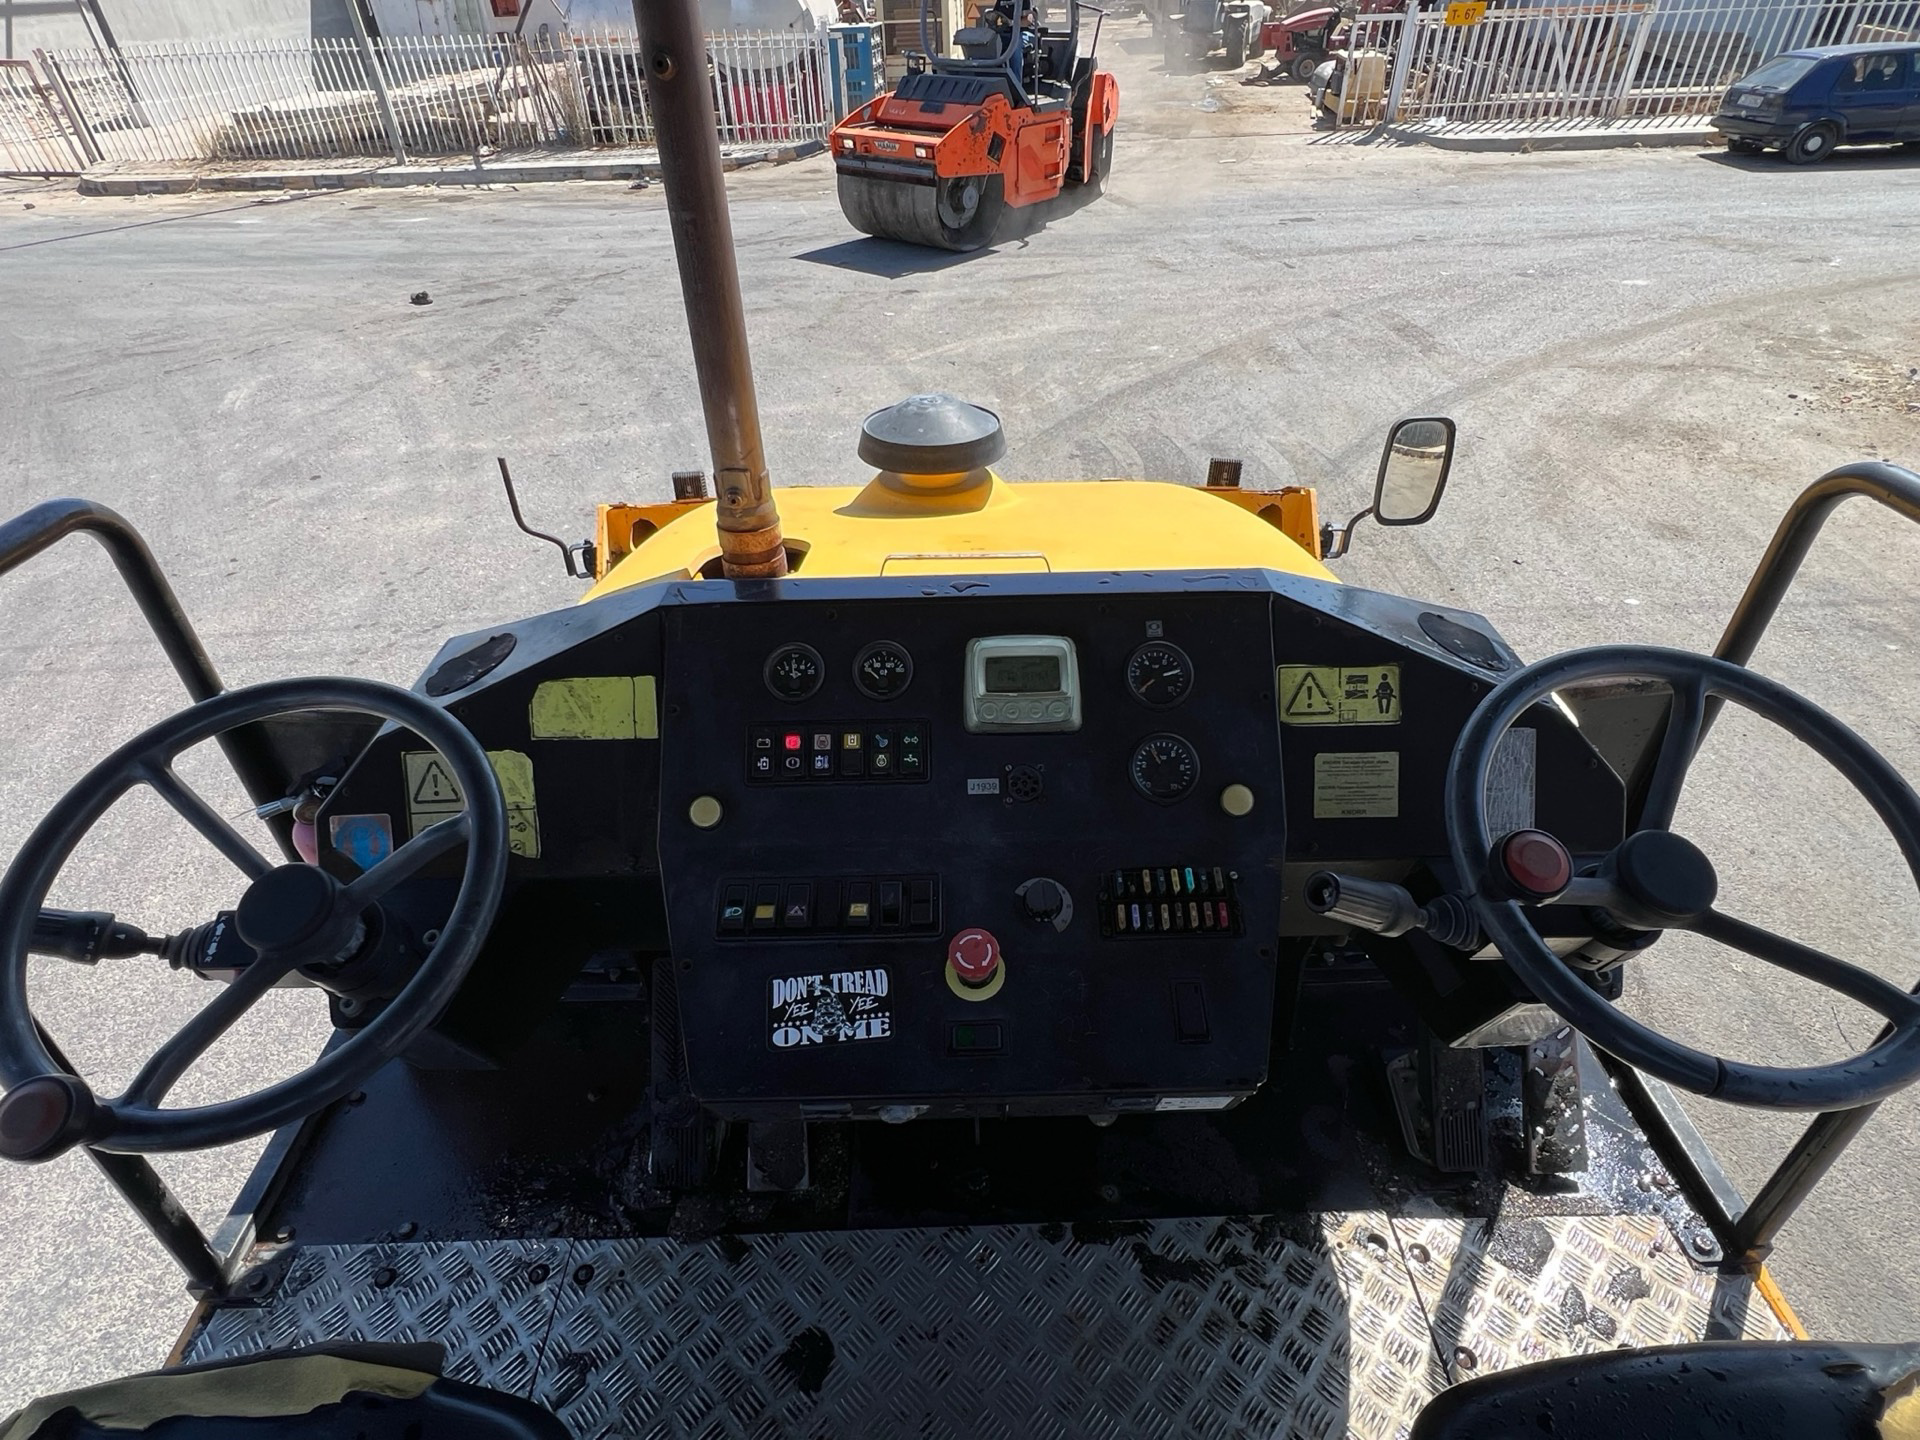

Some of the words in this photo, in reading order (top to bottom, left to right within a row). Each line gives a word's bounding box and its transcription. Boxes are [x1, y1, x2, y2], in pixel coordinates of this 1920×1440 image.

[1464, 8, 1477, 20] 67
[970, 782, 998, 792] J1939
[772, 974, 824, 1009] DON'T
[829, 968, 889, 997] TREAD
[783, 1002, 814, 1021] YEE
[848, 995, 879, 1015] YEE
[772, 1025, 824, 1047] ON
[838, 1017, 892, 1042] ME
